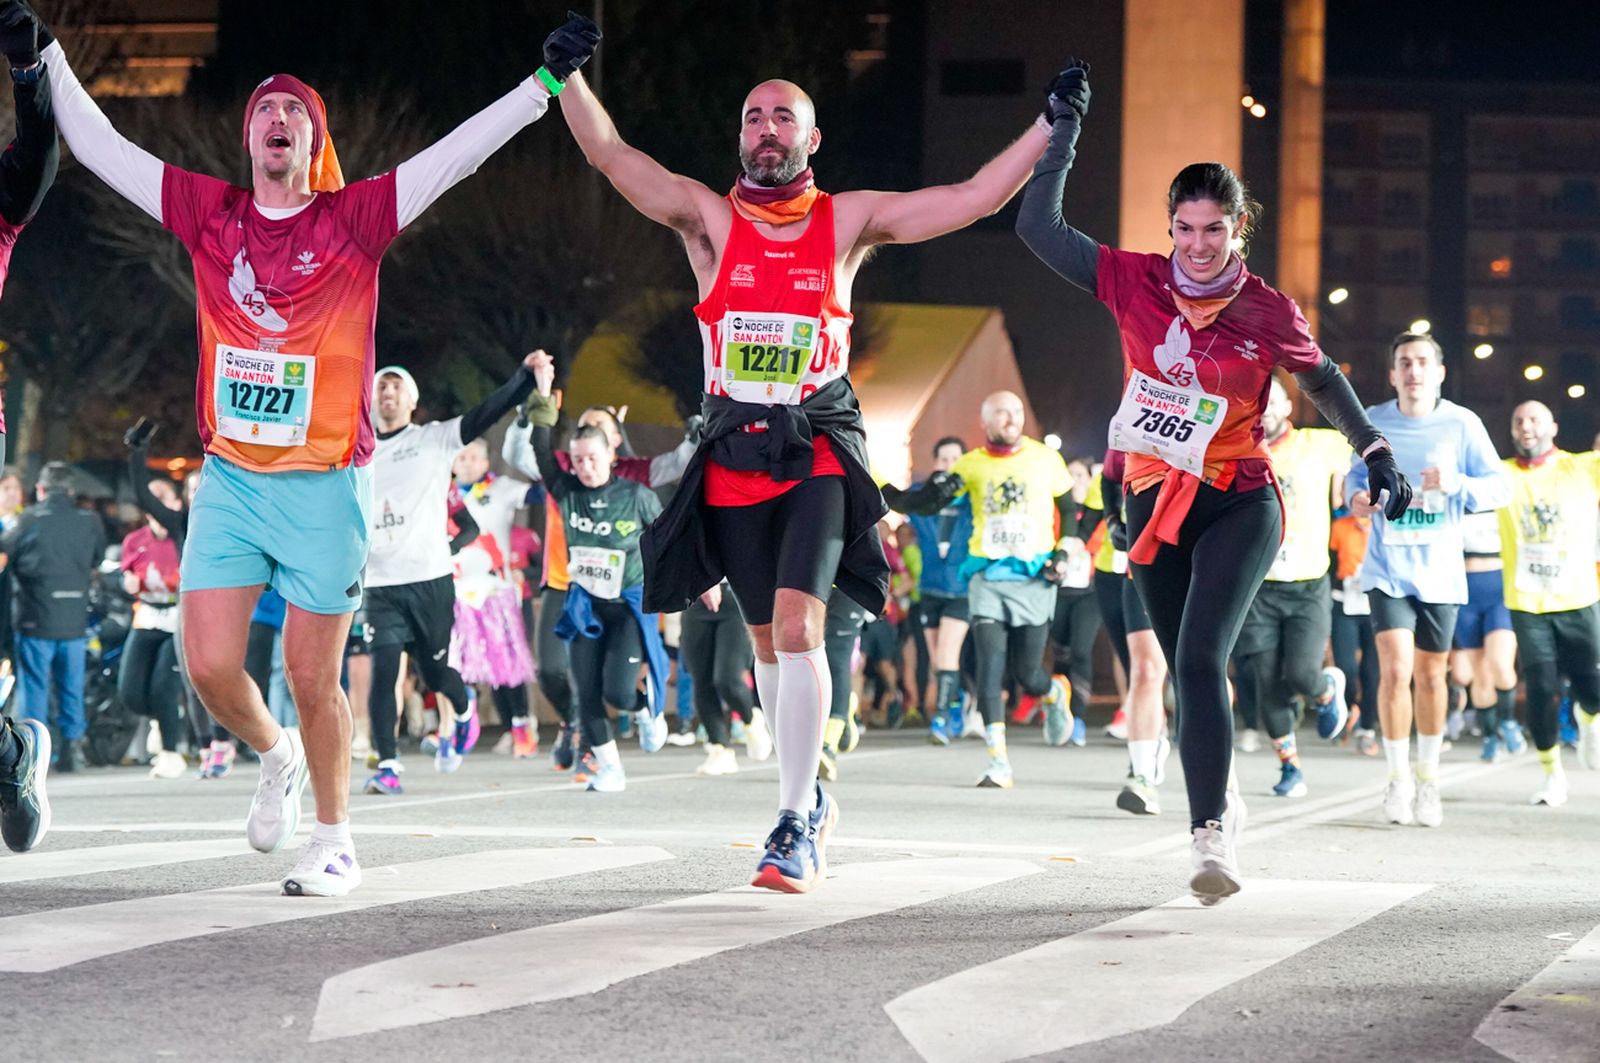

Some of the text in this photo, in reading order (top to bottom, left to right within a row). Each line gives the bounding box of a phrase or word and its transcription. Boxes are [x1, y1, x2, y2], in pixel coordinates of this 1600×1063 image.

[242, 293, 265, 316] 43
[744, 322, 772, 332] NOCHE
[774, 323, 784, 333] DE
[733, 332, 752, 342] SAN
[234, 360, 275, 372] NOCHE DE
[740, 345, 801, 374] 12211
[225, 368, 240, 379] SAN
[1166, 362, 1194, 388] 43
[229, 381, 295, 414] 12727
[1136, 393, 1154, 408] SAN
[1148, 388, 1177, 404] NOCHE
[1178, 396, 1190, 406] DE
[1132, 408, 1196, 442] 7365
